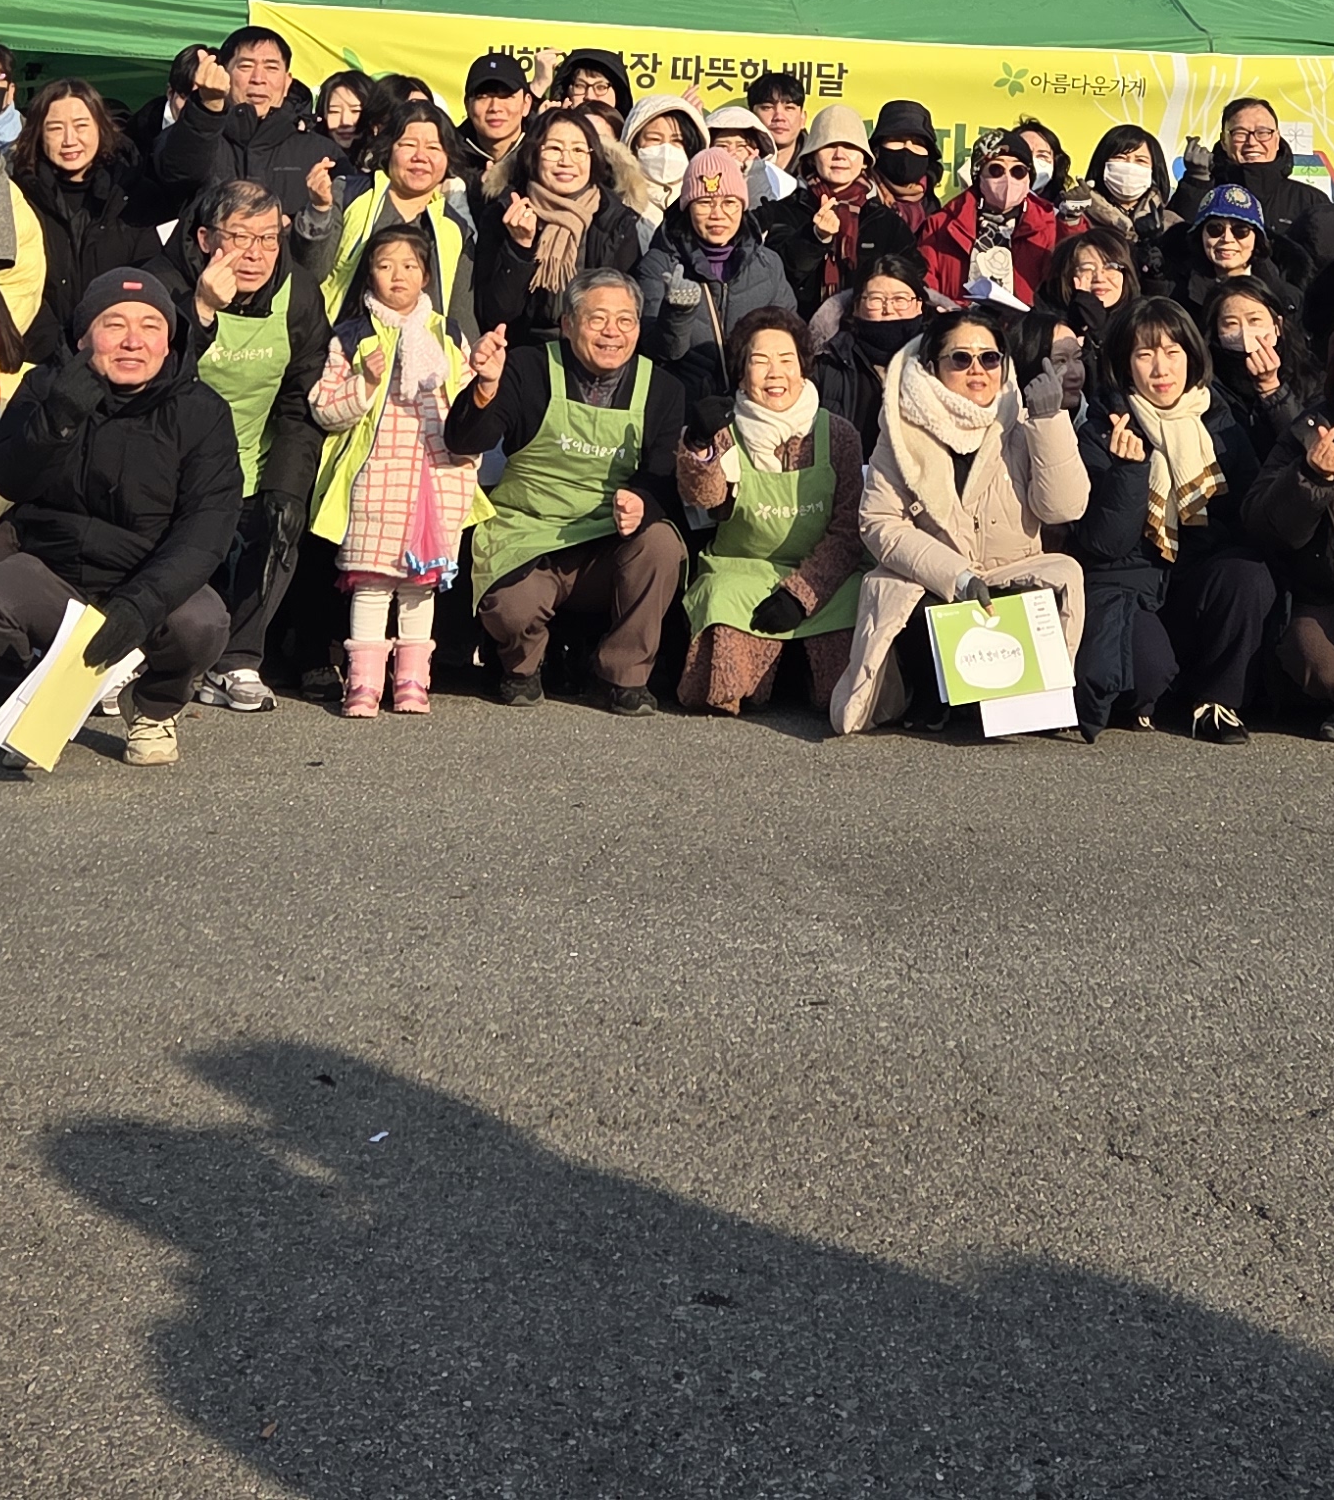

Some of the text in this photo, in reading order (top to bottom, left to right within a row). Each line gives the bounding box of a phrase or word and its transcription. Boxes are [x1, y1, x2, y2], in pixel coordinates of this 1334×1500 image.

[670, 54, 772, 92] 따뜻한
[782, 61, 849, 98] 배달
[1030, 72, 1147, 98] 아름다운가게
